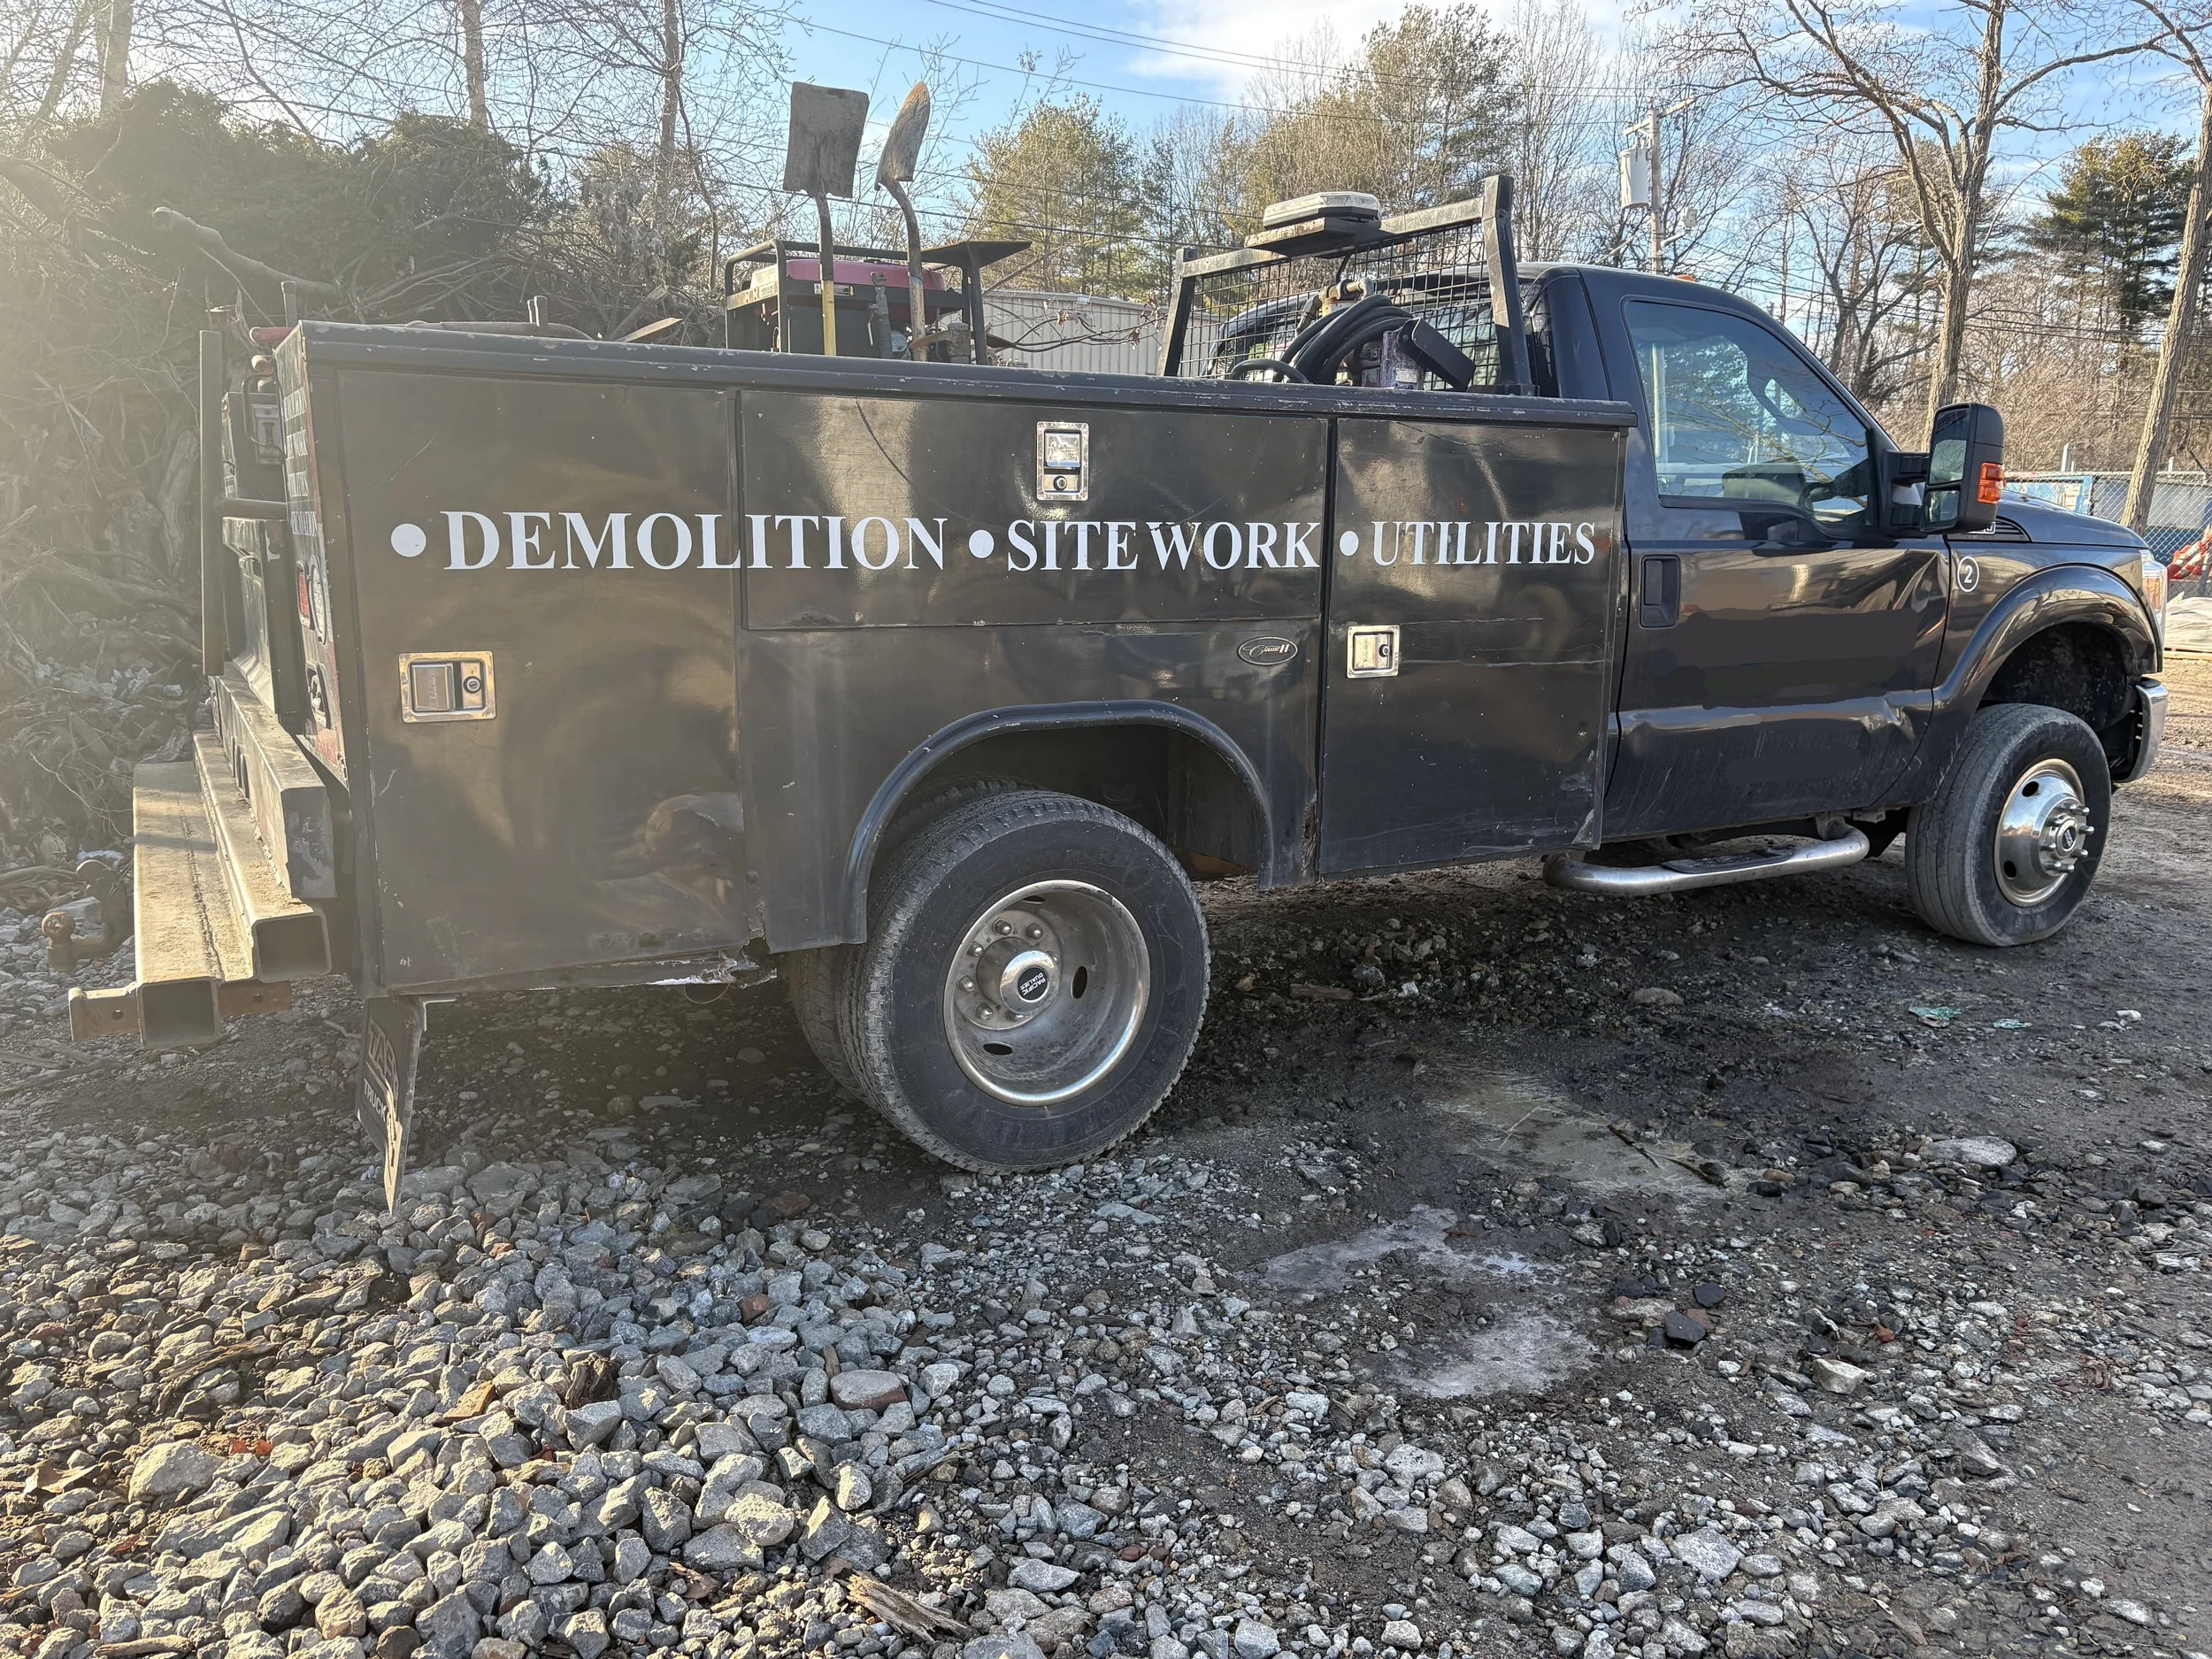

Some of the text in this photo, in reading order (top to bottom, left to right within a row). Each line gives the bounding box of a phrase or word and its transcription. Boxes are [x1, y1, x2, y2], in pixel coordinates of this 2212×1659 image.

[440, 511, 1595, 571] DEMOLITION SITE WORK UTILITIES
[1964, 565, 1973, 584] 2
[1019, 972, 1044, 991] DUALIES
[1021, 977, 1046, 995] PACIFIC
